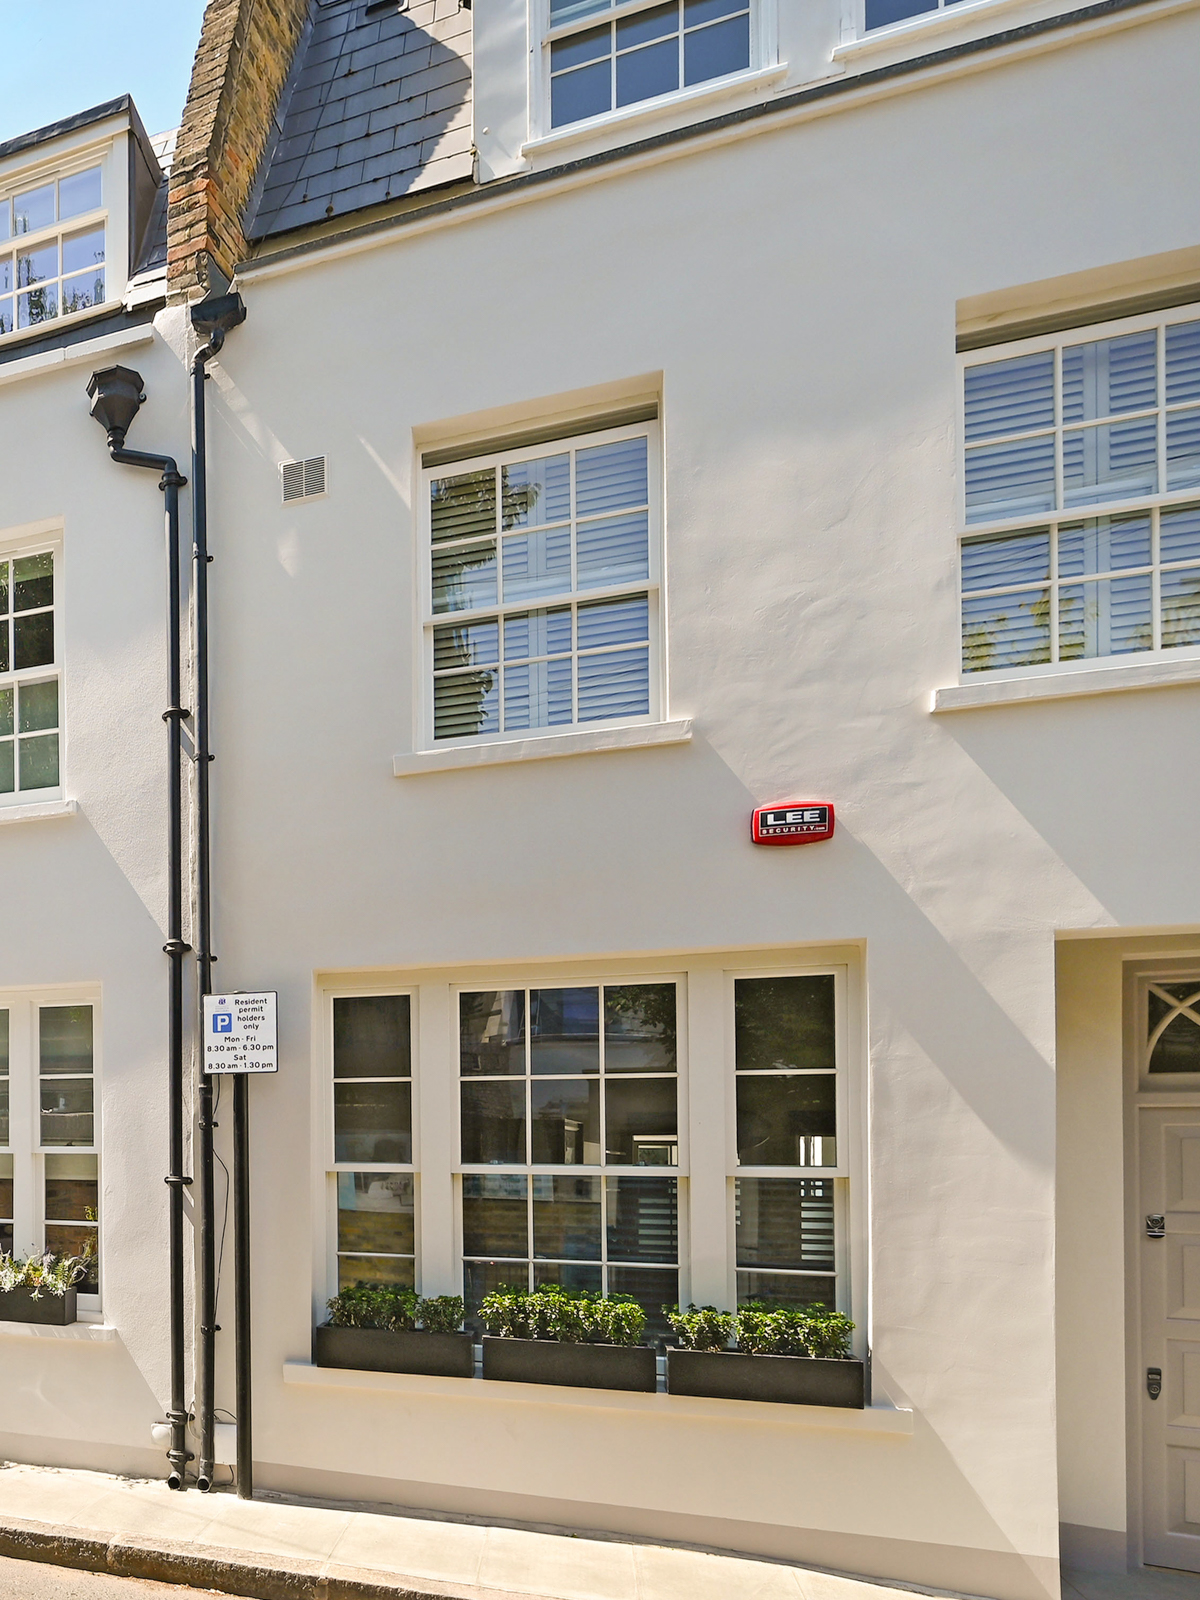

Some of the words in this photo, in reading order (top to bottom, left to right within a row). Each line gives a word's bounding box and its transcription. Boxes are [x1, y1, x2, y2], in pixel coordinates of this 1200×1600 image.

[767, 810, 820, 825] LEE
[234, 998, 268, 1006] Resident
[238, 1006, 264, 1014] permit
[217, 1015, 230, 1032] P
[243, 1023, 260, 1031] only
[242, 1043, 260, 1051] 6.30
[208, 1062, 226, 1070] 8.30
[243, 1061, 260, 1069] 1.30
